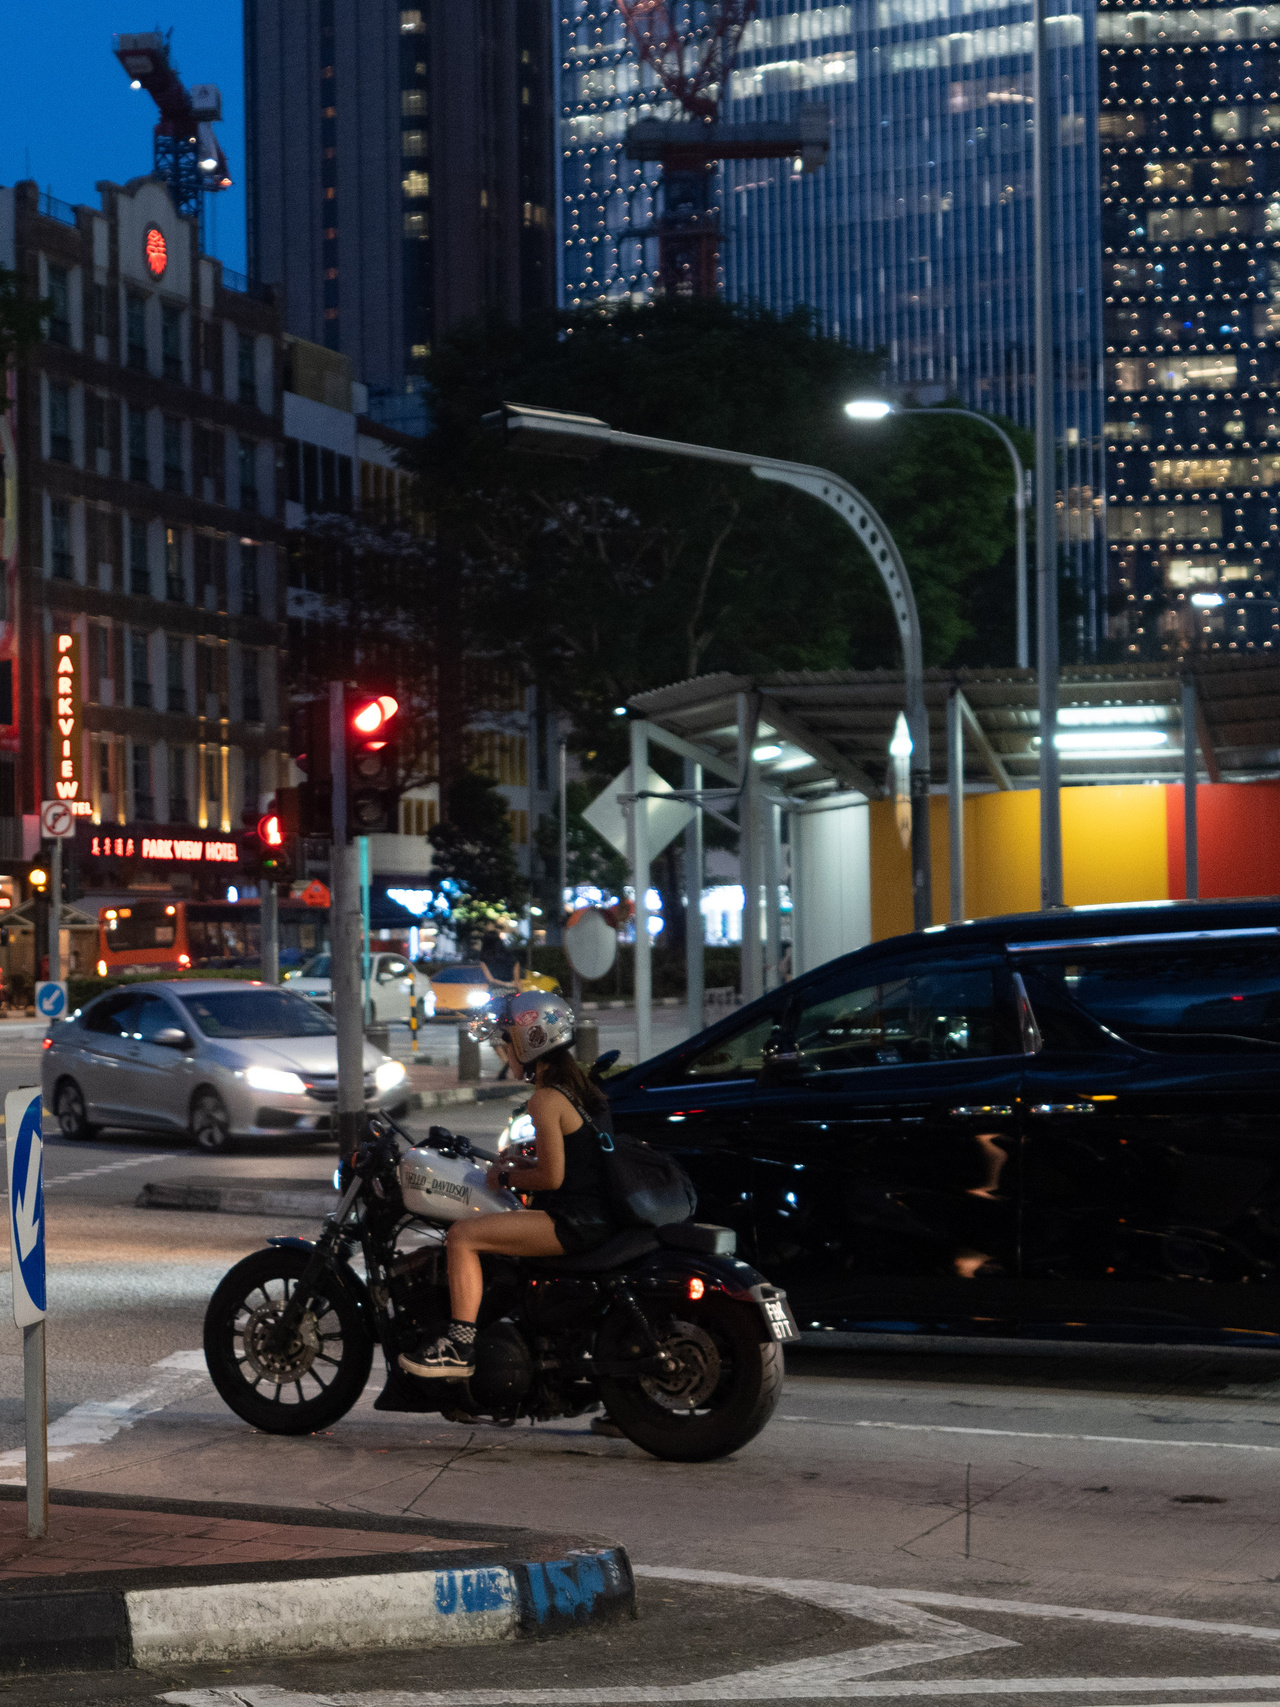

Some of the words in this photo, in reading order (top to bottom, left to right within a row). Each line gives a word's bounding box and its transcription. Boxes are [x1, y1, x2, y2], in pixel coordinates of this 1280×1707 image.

[56, 634, 79, 800] PARKVIEW
[142, 838, 173, 860] PARK
[173, 839, 204, 861] VIEW
[205, 841, 239, 863] HOTEL
[431, 1178, 473, 1206] DAVIDSON
